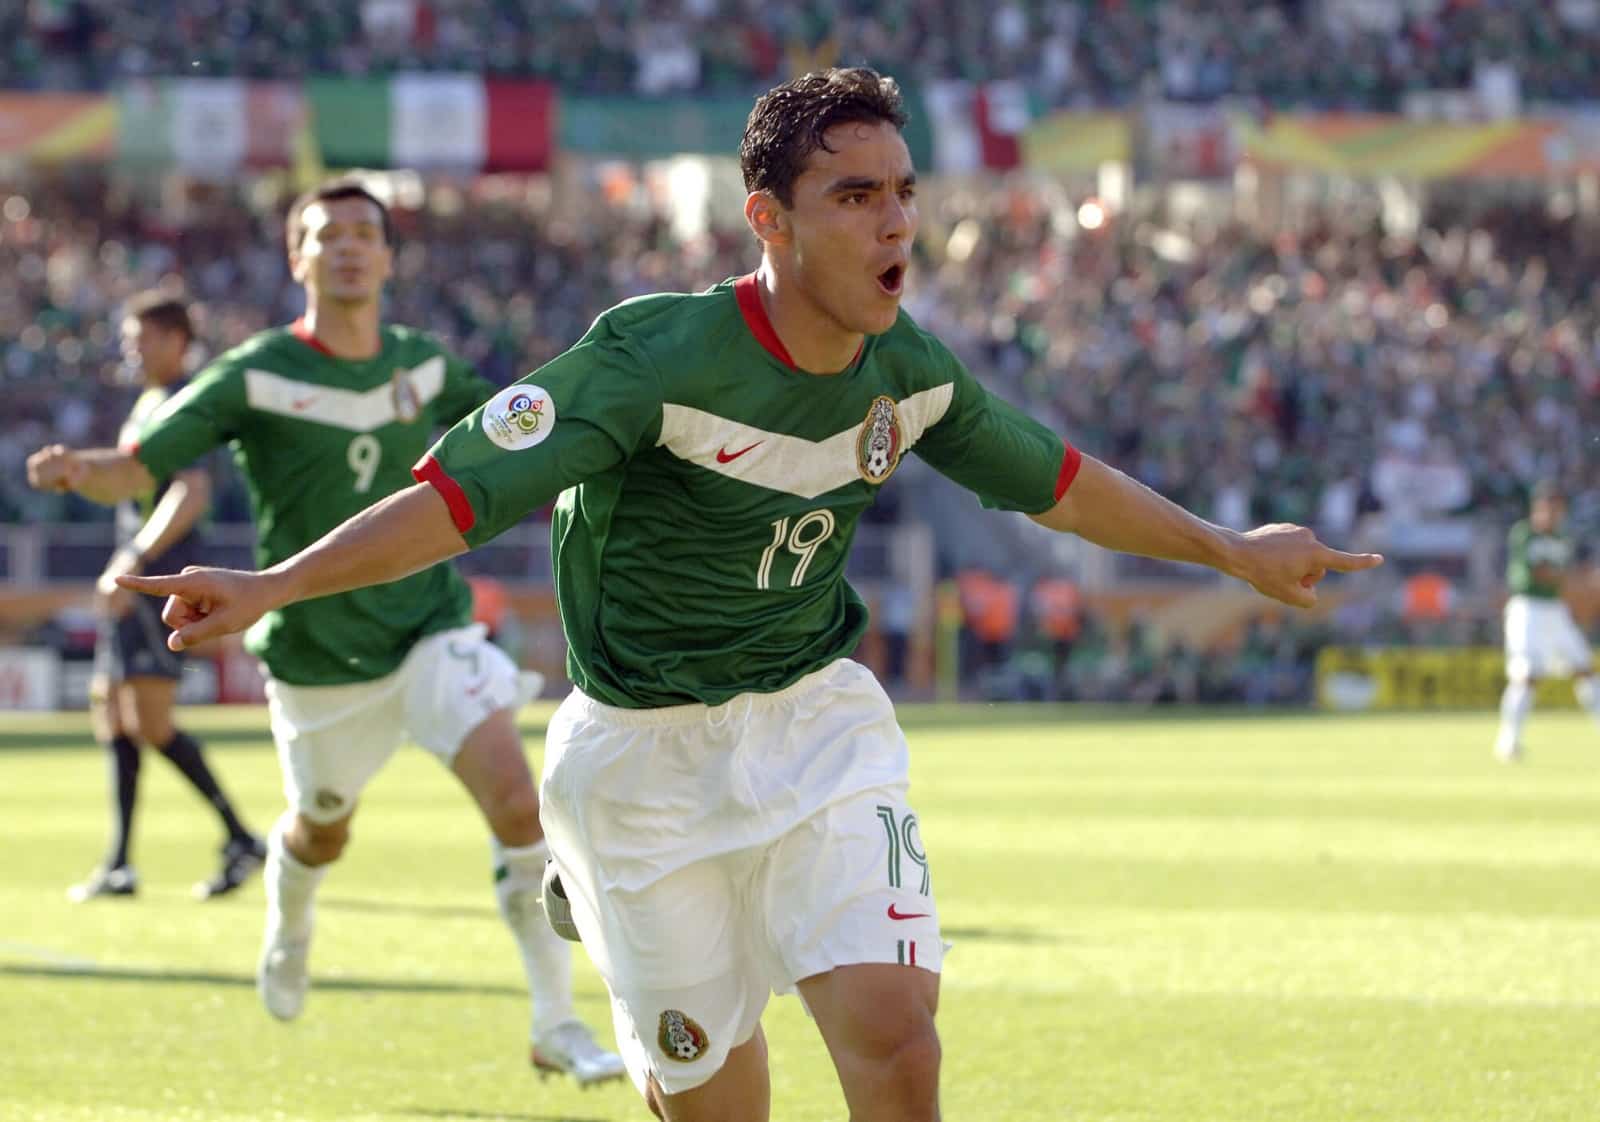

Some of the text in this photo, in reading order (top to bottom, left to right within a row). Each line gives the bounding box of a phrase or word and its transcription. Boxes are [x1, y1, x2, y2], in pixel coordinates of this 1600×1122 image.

[347, 435, 382, 492] 9
[757, 509, 835, 590] 19
[876, 805, 930, 897] 19
